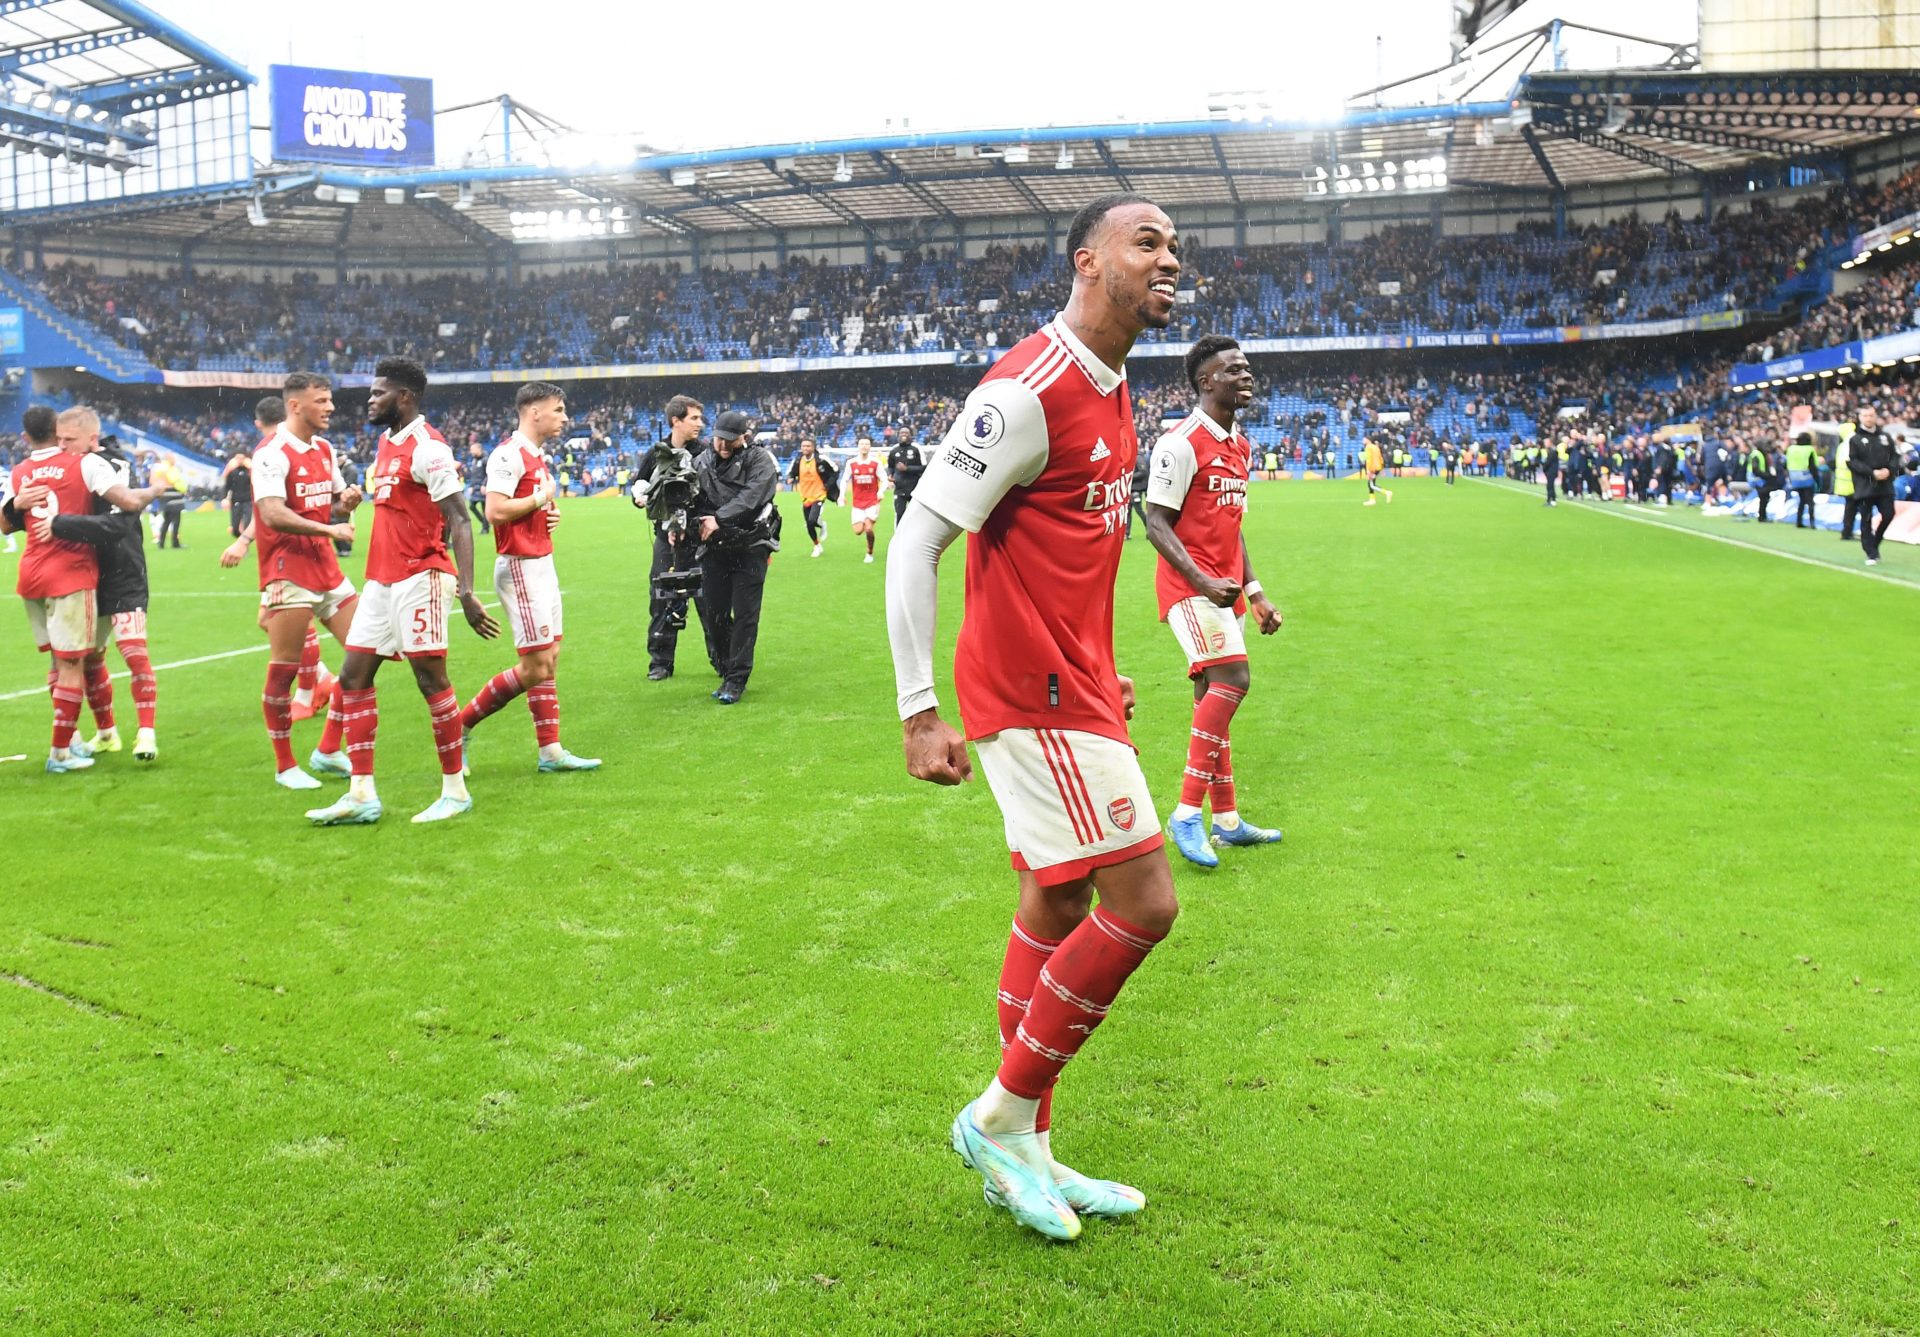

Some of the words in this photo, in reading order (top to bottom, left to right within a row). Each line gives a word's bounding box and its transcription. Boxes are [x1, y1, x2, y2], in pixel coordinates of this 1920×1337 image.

[303, 85, 367, 117] AVOID
[369, 90, 406, 119] THE
[304, 112, 407, 151] CROWDS
[1240, 339, 1288, 353] ANKIE
[1290, 336, 1368, 351] LAMPARD
[1416, 334, 1446, 346] TAKING
[1448, 334, 1462, 345] THE
[959, 453, 983, 473] room
[412, 608, 427, 634] 5
